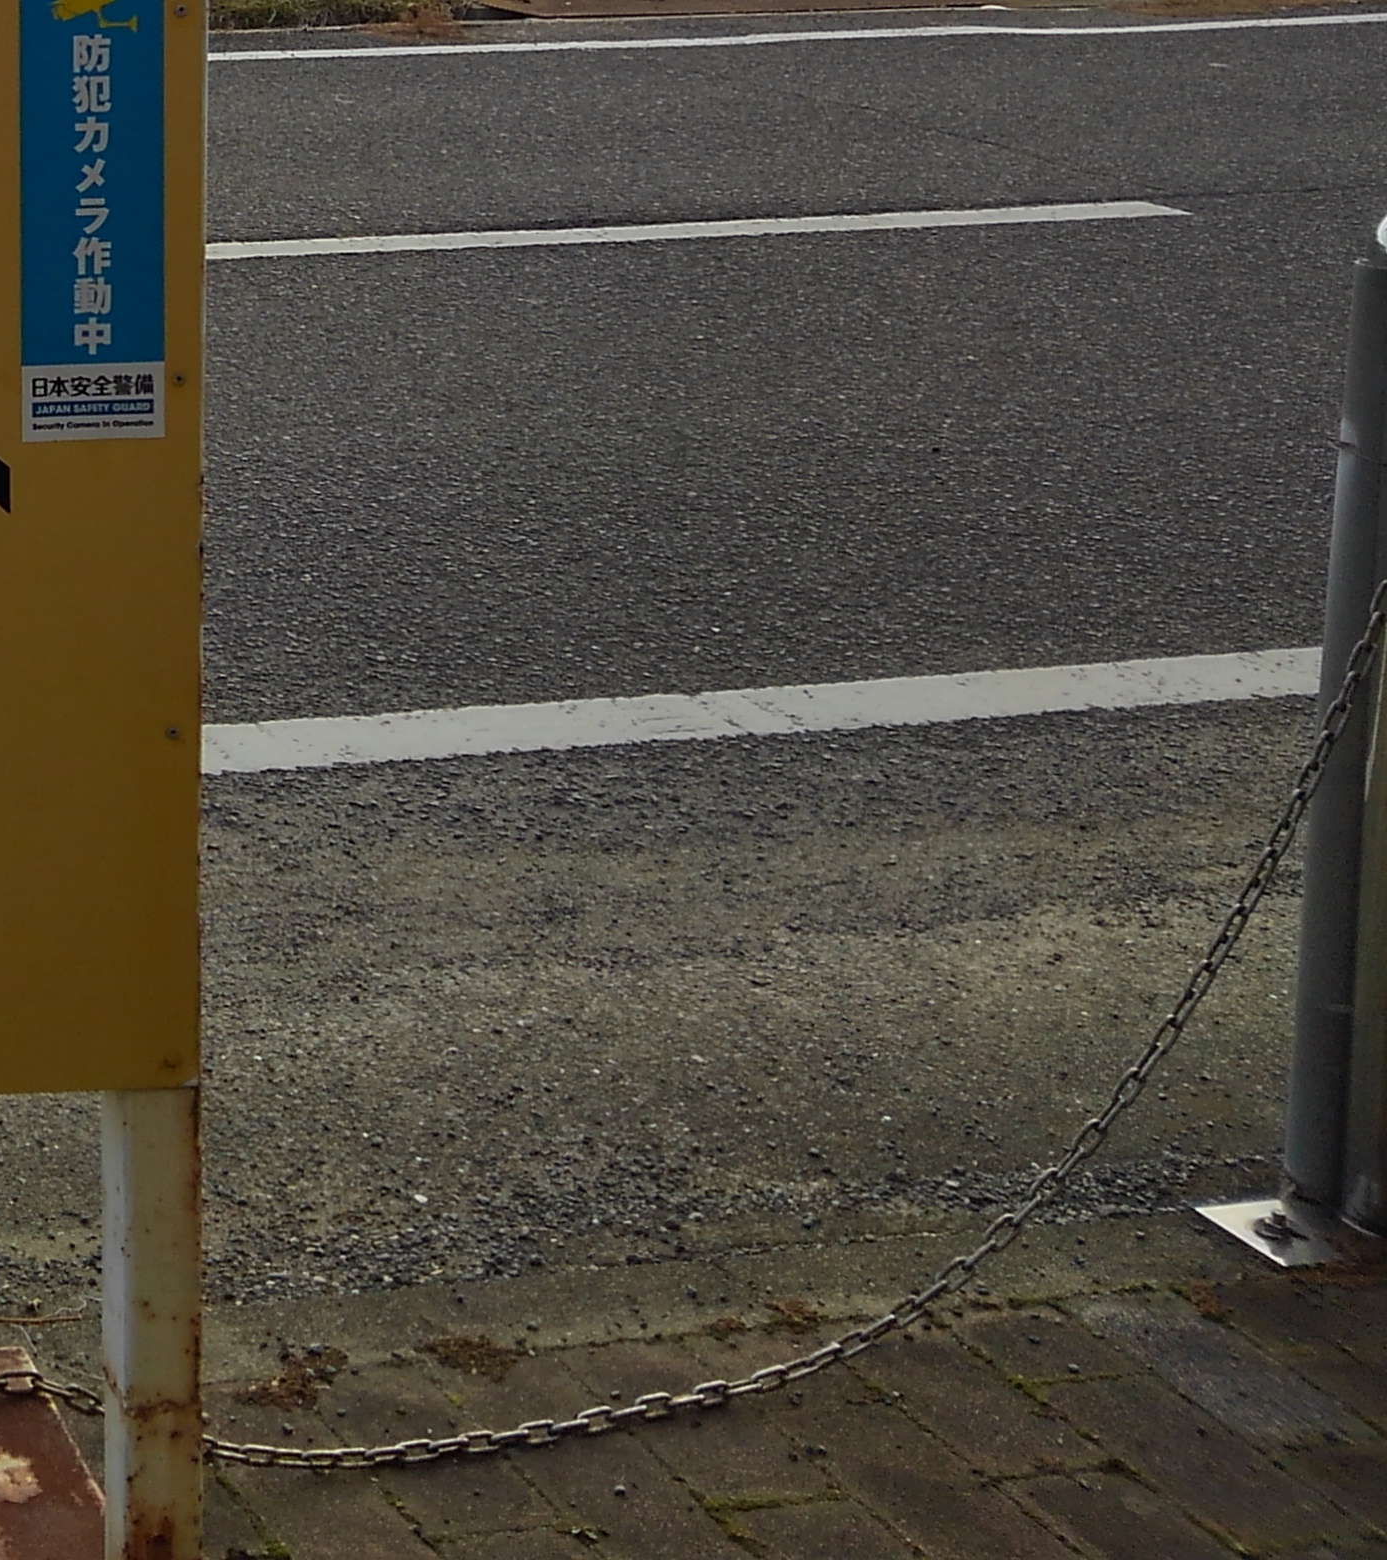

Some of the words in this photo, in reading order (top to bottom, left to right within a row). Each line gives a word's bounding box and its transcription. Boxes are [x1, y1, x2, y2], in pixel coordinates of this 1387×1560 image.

[73, 33, 113, 356] 防犯カメラ作動中
[31, 373, 155, 397] 日本安全警備
[35, 404, 71, 415] JAPAN
[73, 403, 110, 414] SAFETY
[112, 402, 151, 412] GUARD
[32, 423, 65, 431] Security
[66, 421, 101, 429] Camera
[112, 420, 155, 428] Operation
